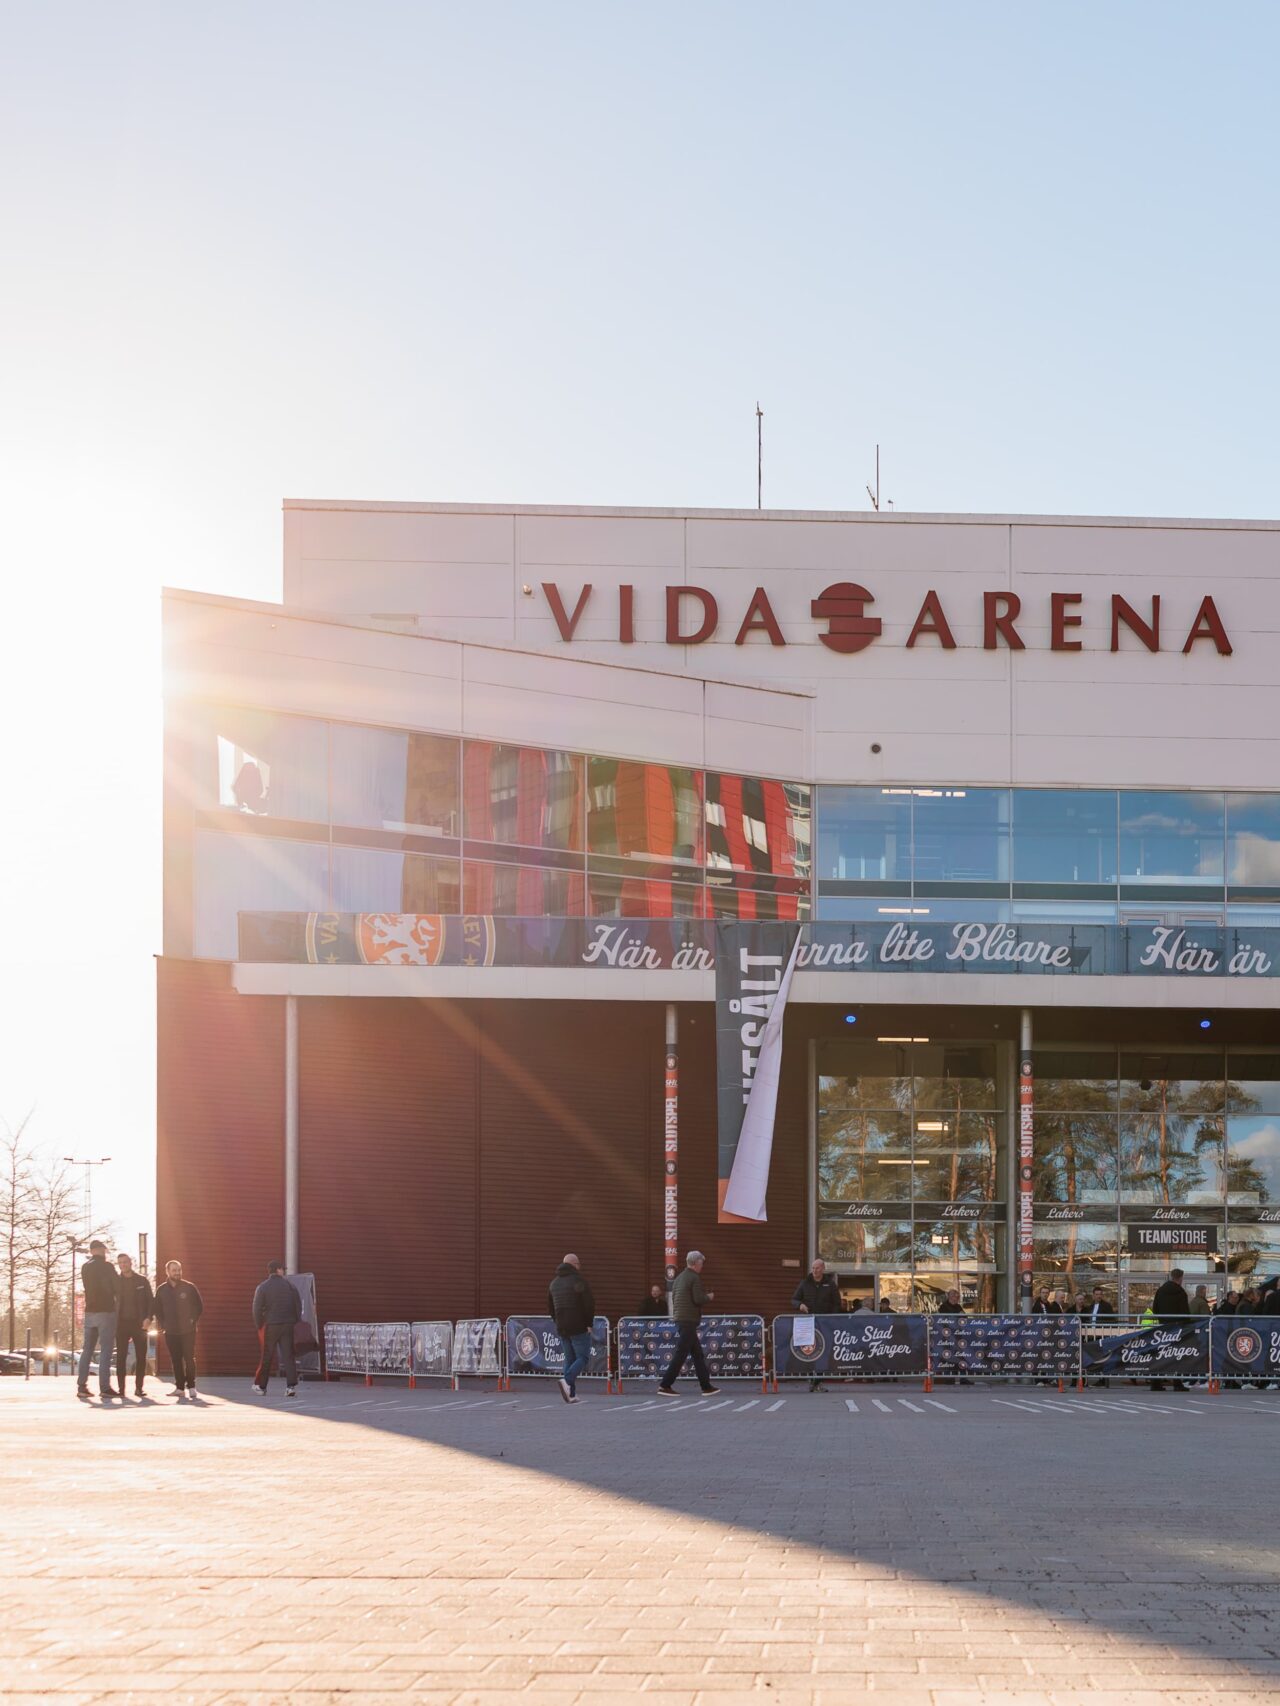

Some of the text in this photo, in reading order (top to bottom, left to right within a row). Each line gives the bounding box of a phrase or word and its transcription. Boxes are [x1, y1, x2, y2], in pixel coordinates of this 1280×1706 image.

[541, 583, 1234, 656] VIDA ARENA
[582, 924, 662, 970] Här
[671, 941, 716, 970] är
[880, 922, 935, 963] lite
[946, 922, 1071, 968] Blåare
[1140, 926, 1218, 972] Här
[1228, 942, 1271, 974] är
[665, 1096, 678, 1152] SLUTSPEL
[1021, 1103, 1033, 1158] SLUTSPEL
[665, 1184, 678, 1240] SLUTSPEL
[844, 1203, 883, 1216] Lakers
[941, 1205, 980, 1217] Lakers
[1021, 1191, 1033, 1245] SLUTSPEL
[1046, 1208, 1084, 1219] Lakers
[1152, 1208, 1190, 1219] Lakers
[1138, 1230, 1207, 1244] TEAMSTORE
[542, 1331, 561, 1346] Vår
[833, 1329, 858, 1345] Vår
[862, 1325, 894, 1342] Stad
[1150, 1328, 1182, 1345] Stad
[833, 1340, 911, 1362] Våra Färger
[1121, 1343, 1199, 1363] Våra Färger
